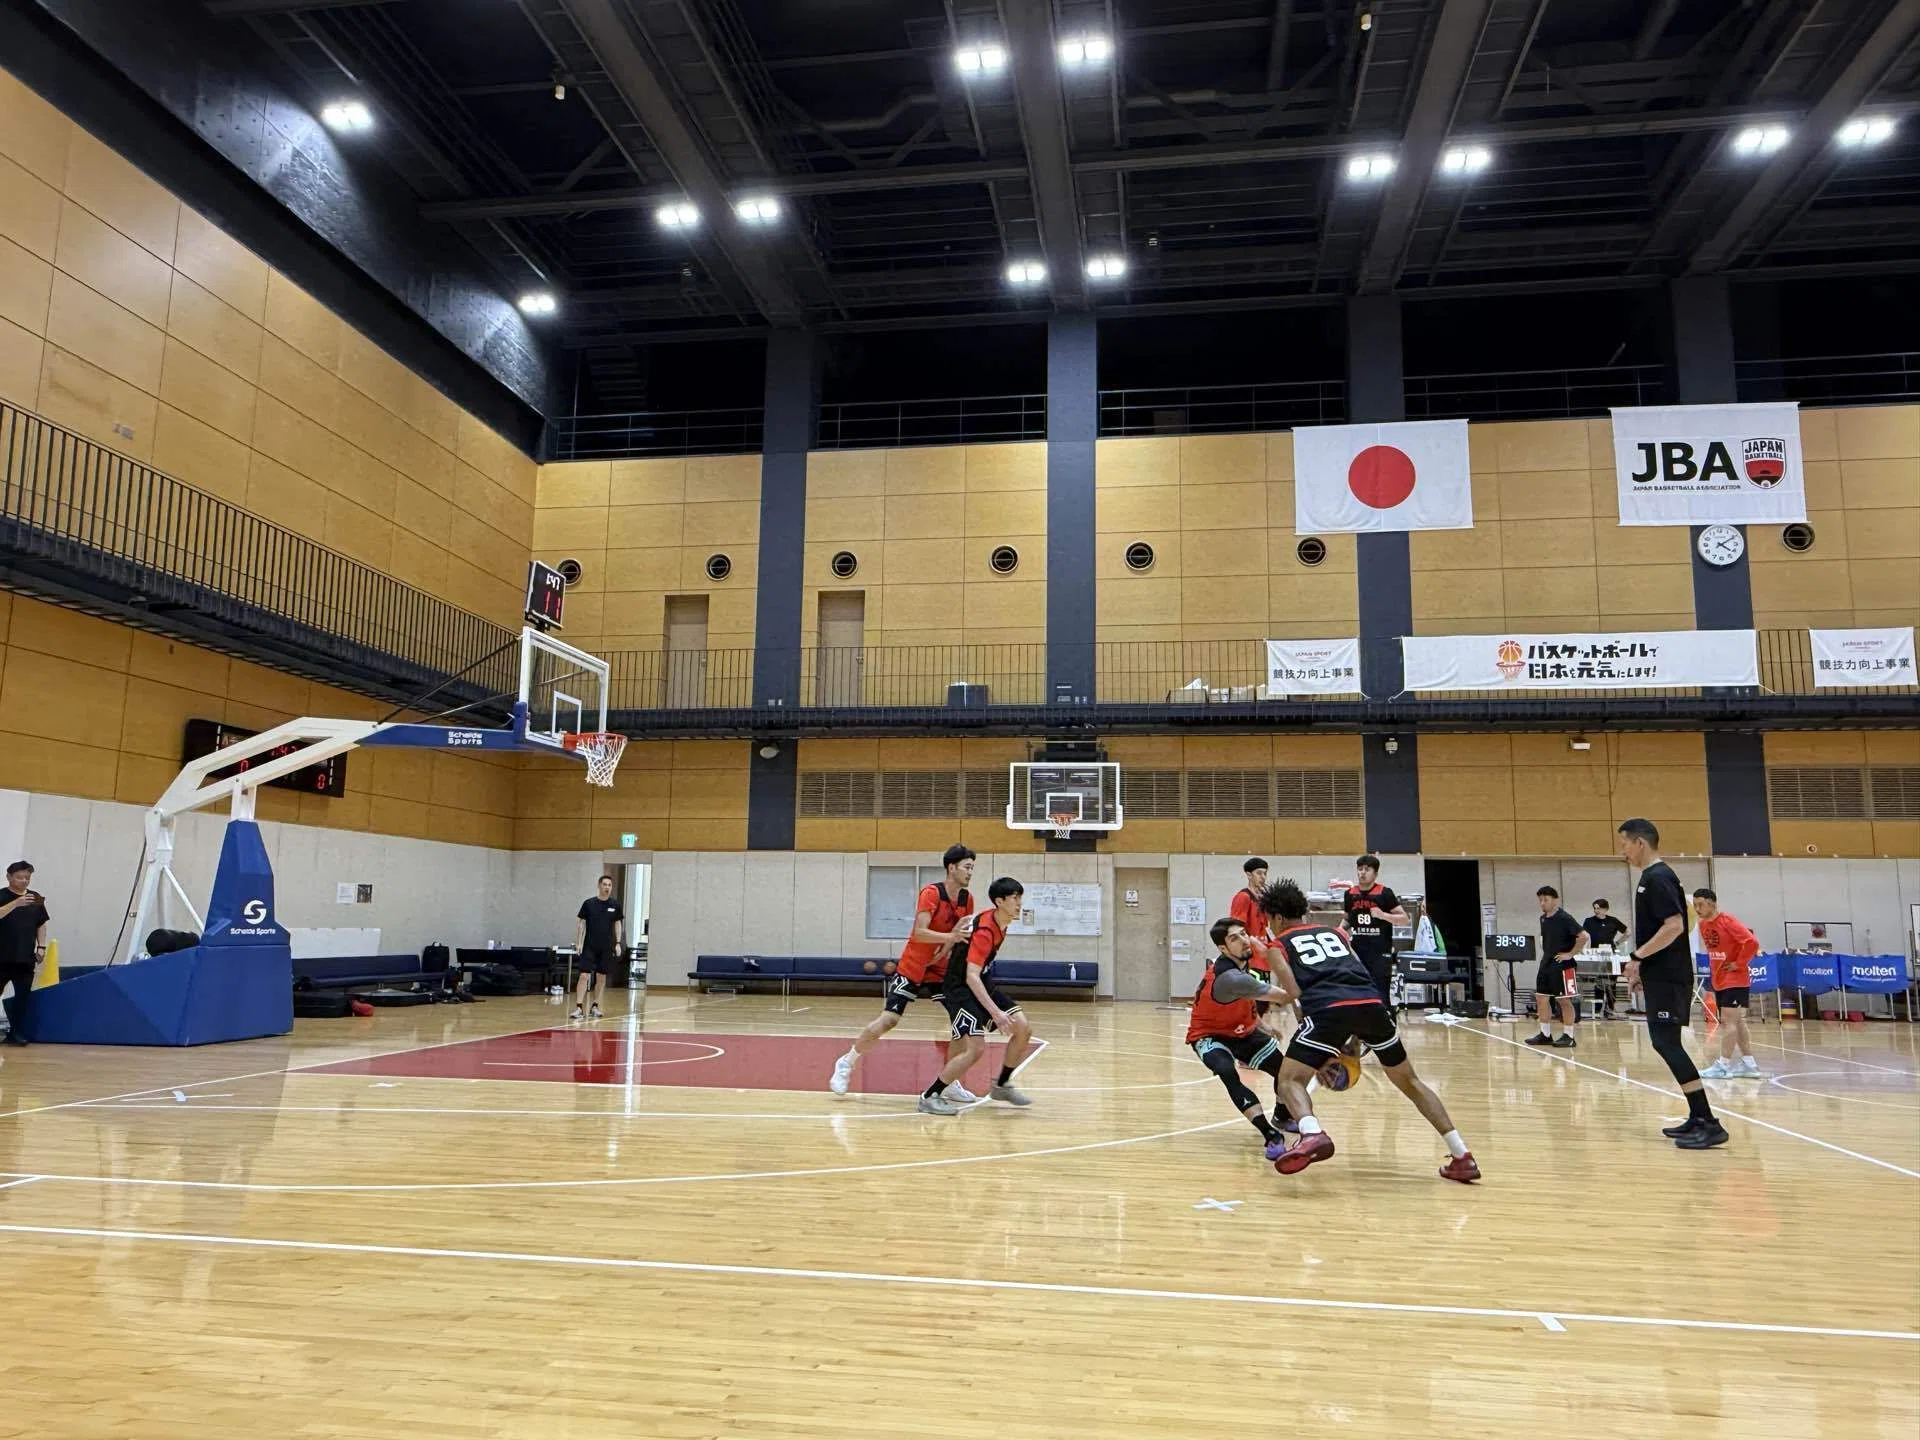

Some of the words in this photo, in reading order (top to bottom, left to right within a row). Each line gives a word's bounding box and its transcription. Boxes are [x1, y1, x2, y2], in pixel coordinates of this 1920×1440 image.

[1744, 440, 1784, 453] JAPAN
[1632, 441, 1740, 482] JBA
[1745, 452, 1784, 460] BASKETBALL
[1528, 640, 1659, 659] バスケットボールで
[1819, 658, 1910, 670] 競技力向上事業
[1273, 667, 1354, 679] 競技力向上事業
[448, 737, 483, 745] Sports
[1495, 935, 1526, 947] 38:49
[1290, 931, 1350, 965] 58
[1802, 967, 1834, 976] molten
[1852, 965, 1897, 977] molten
